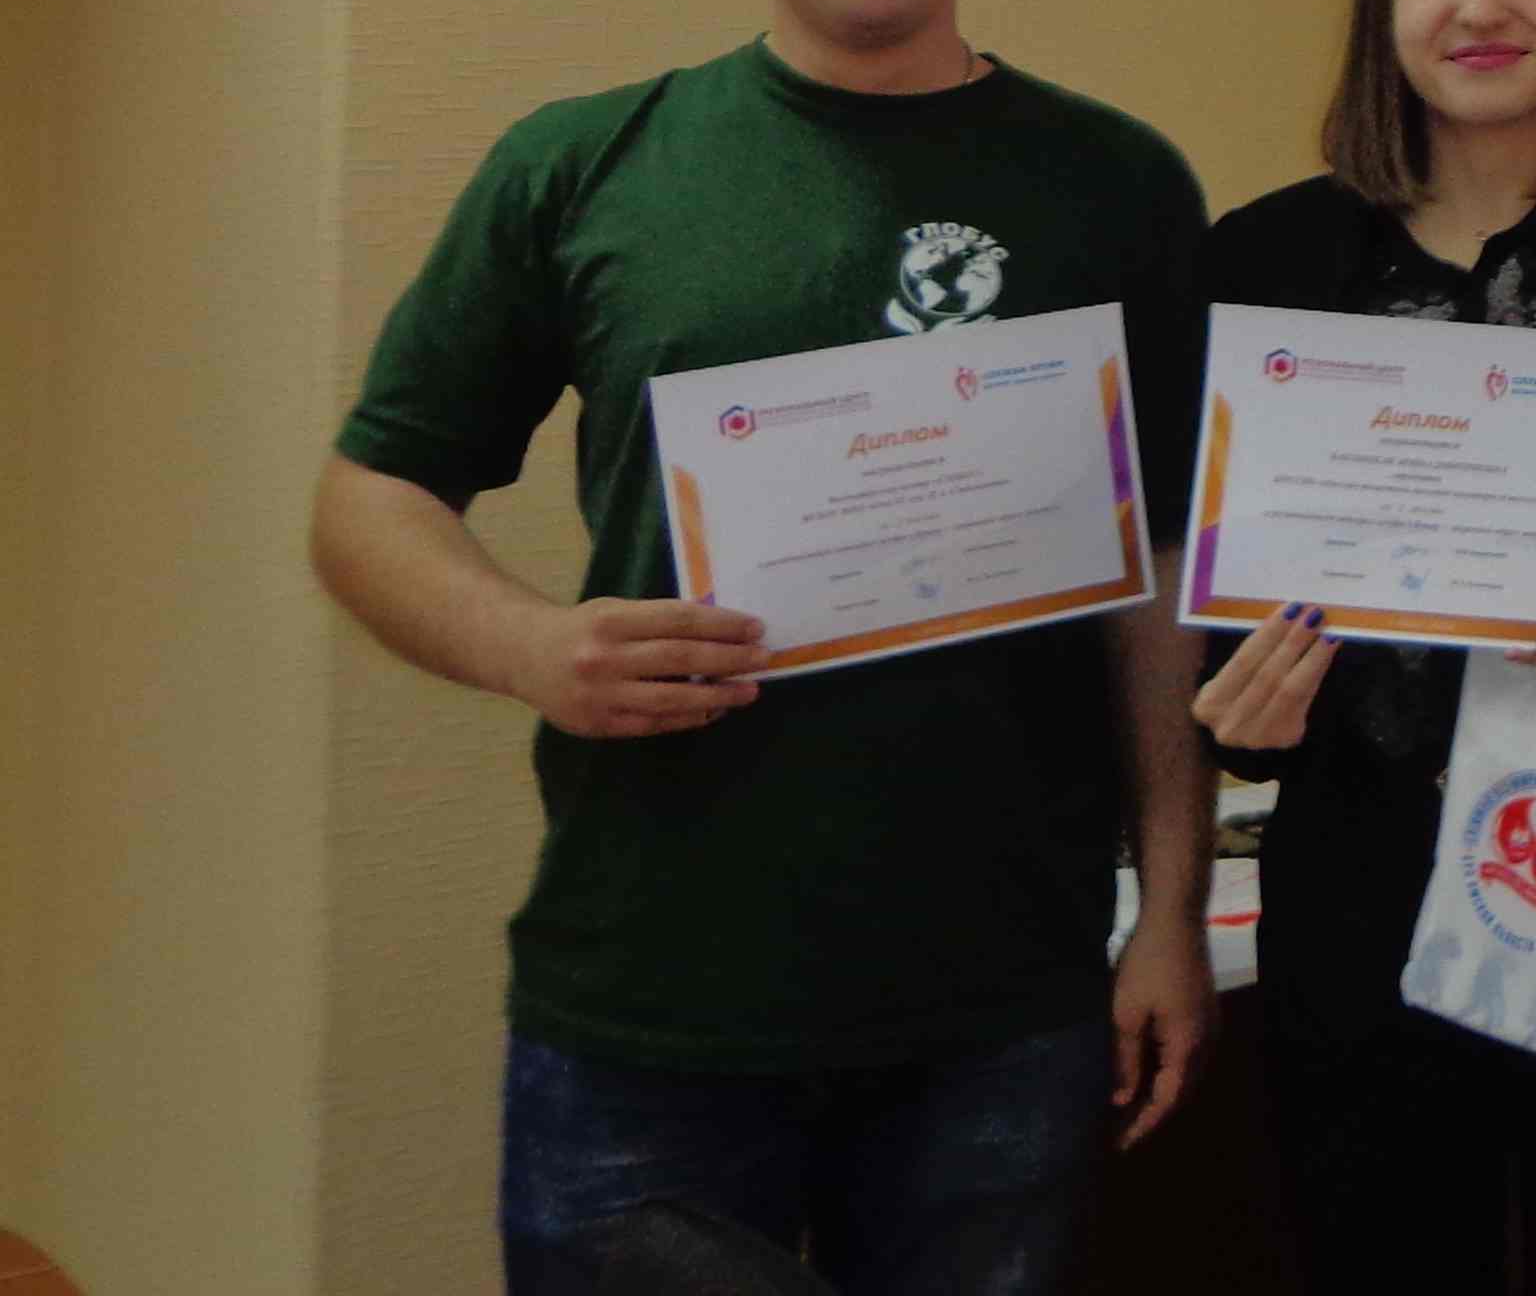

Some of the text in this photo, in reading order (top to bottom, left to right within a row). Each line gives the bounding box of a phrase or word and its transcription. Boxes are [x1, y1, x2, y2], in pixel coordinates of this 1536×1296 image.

[904, 222, 1010, 261] ГЛОБУС
[1369, 405, 1473, 432] Диплом
[847, 424, 951, 460] Диплом
